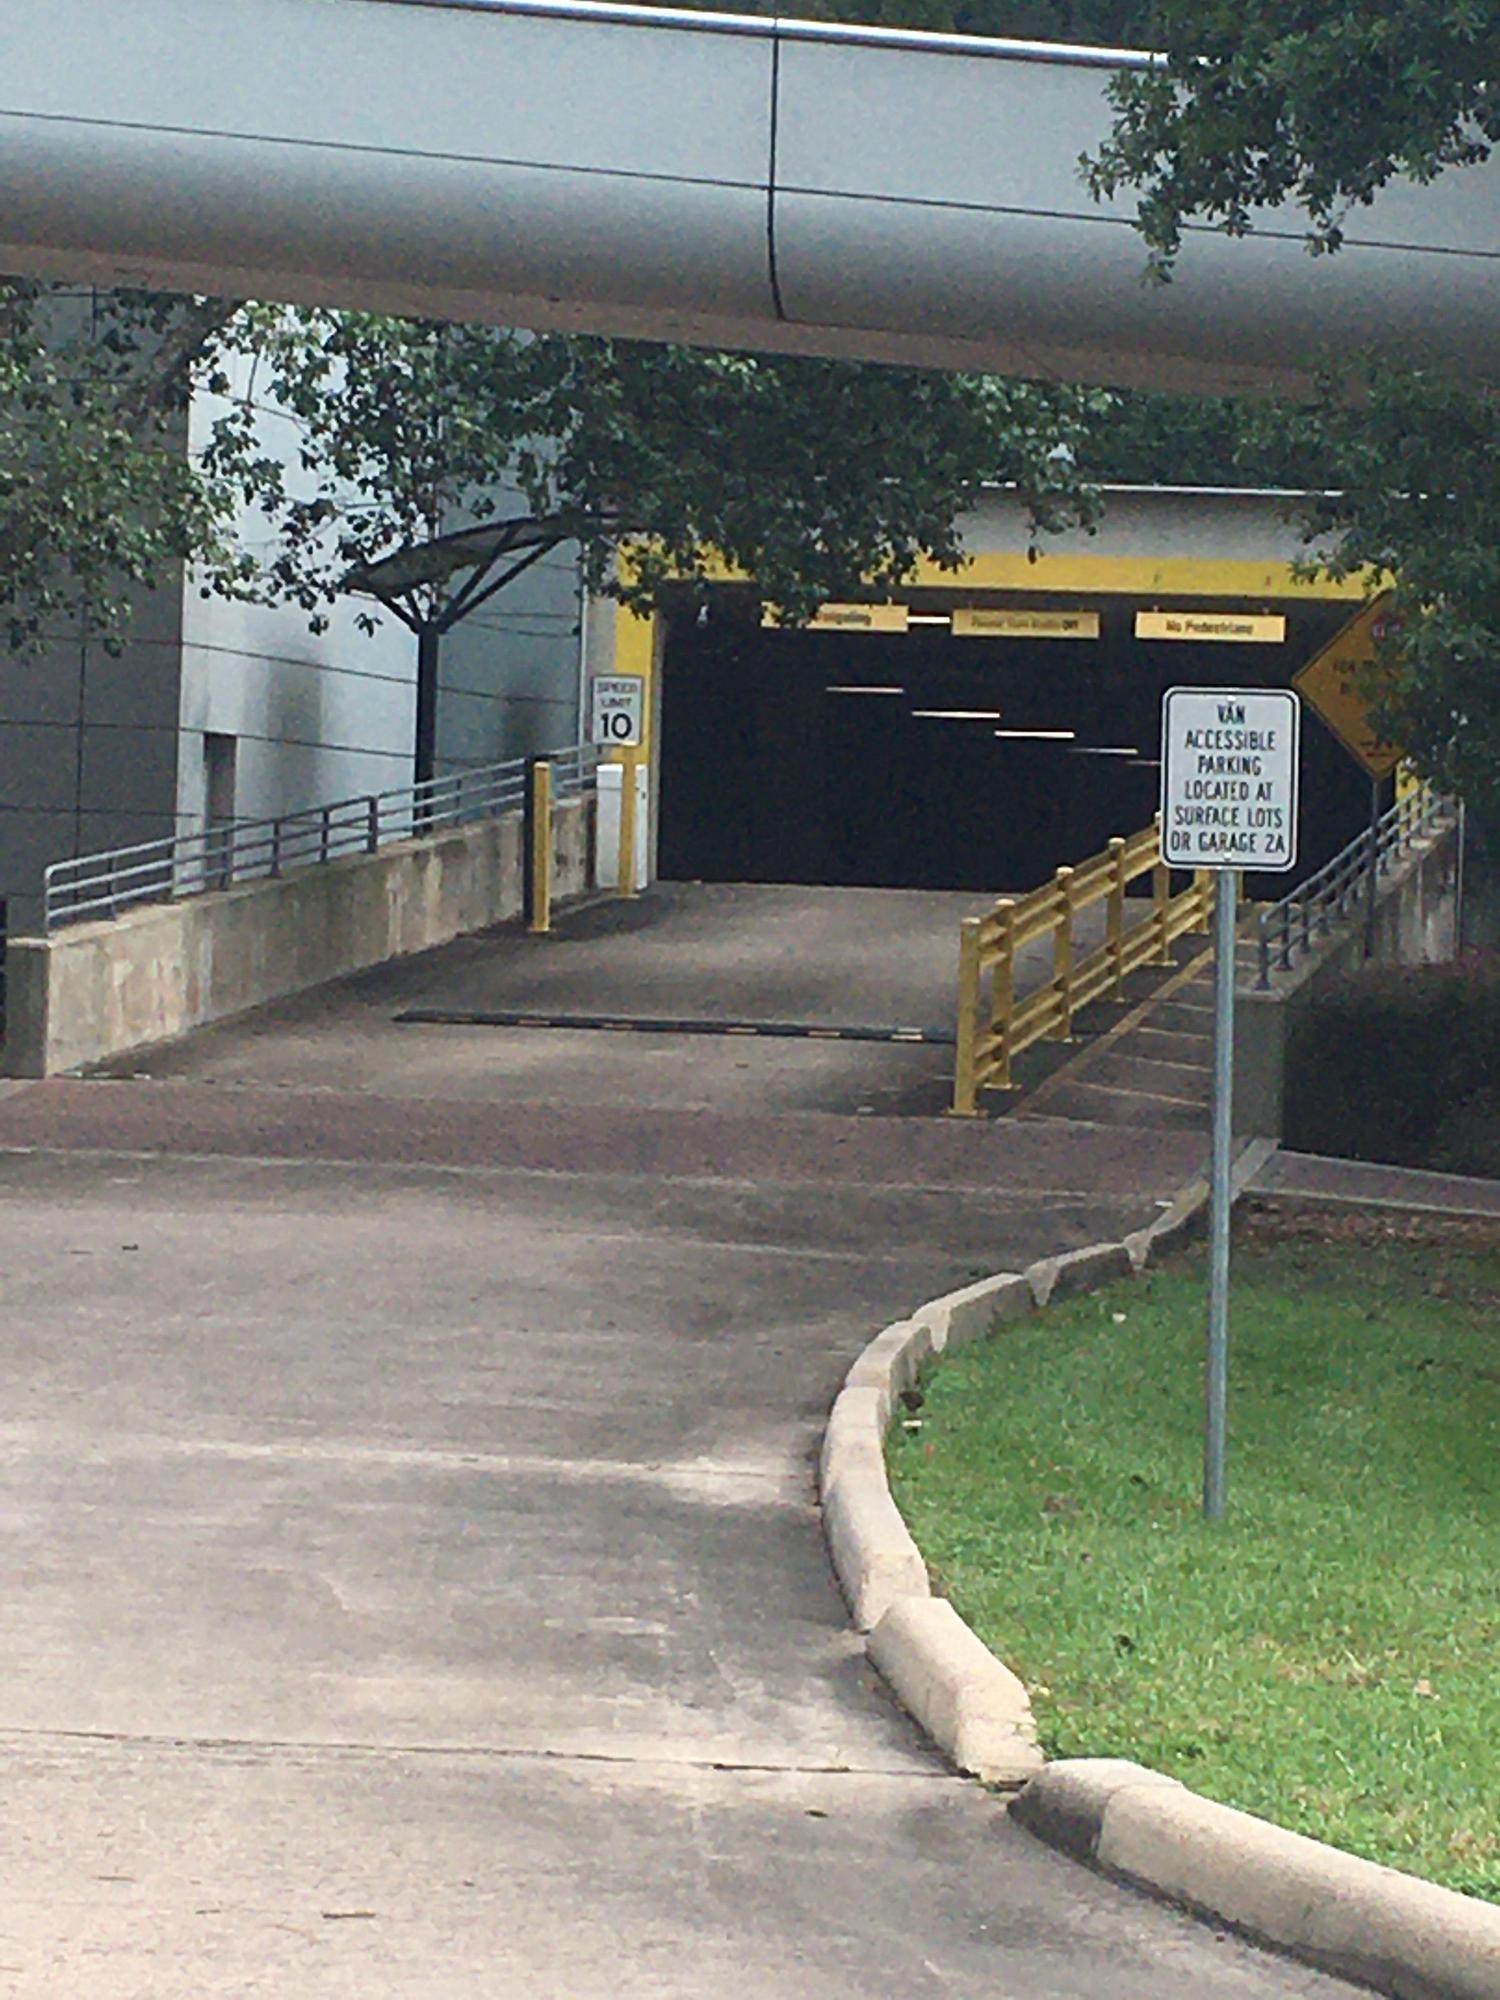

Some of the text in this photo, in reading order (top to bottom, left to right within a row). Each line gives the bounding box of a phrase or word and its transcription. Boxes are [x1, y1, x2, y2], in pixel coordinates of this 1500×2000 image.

[601, 712, 632, 739] 10
[1217, 704, 1246, 725] VAN
[1185, 729, 1277, 751] ACCESSIBLE
[1197, 755, 1262, 776] PARKING
[1185, 780, 1273, 801] LOCATED AT
[1174, 805, 1283, 828] SURFACE LOTS
[1171, 831, 1286, 853] OR GARAGE 2A
